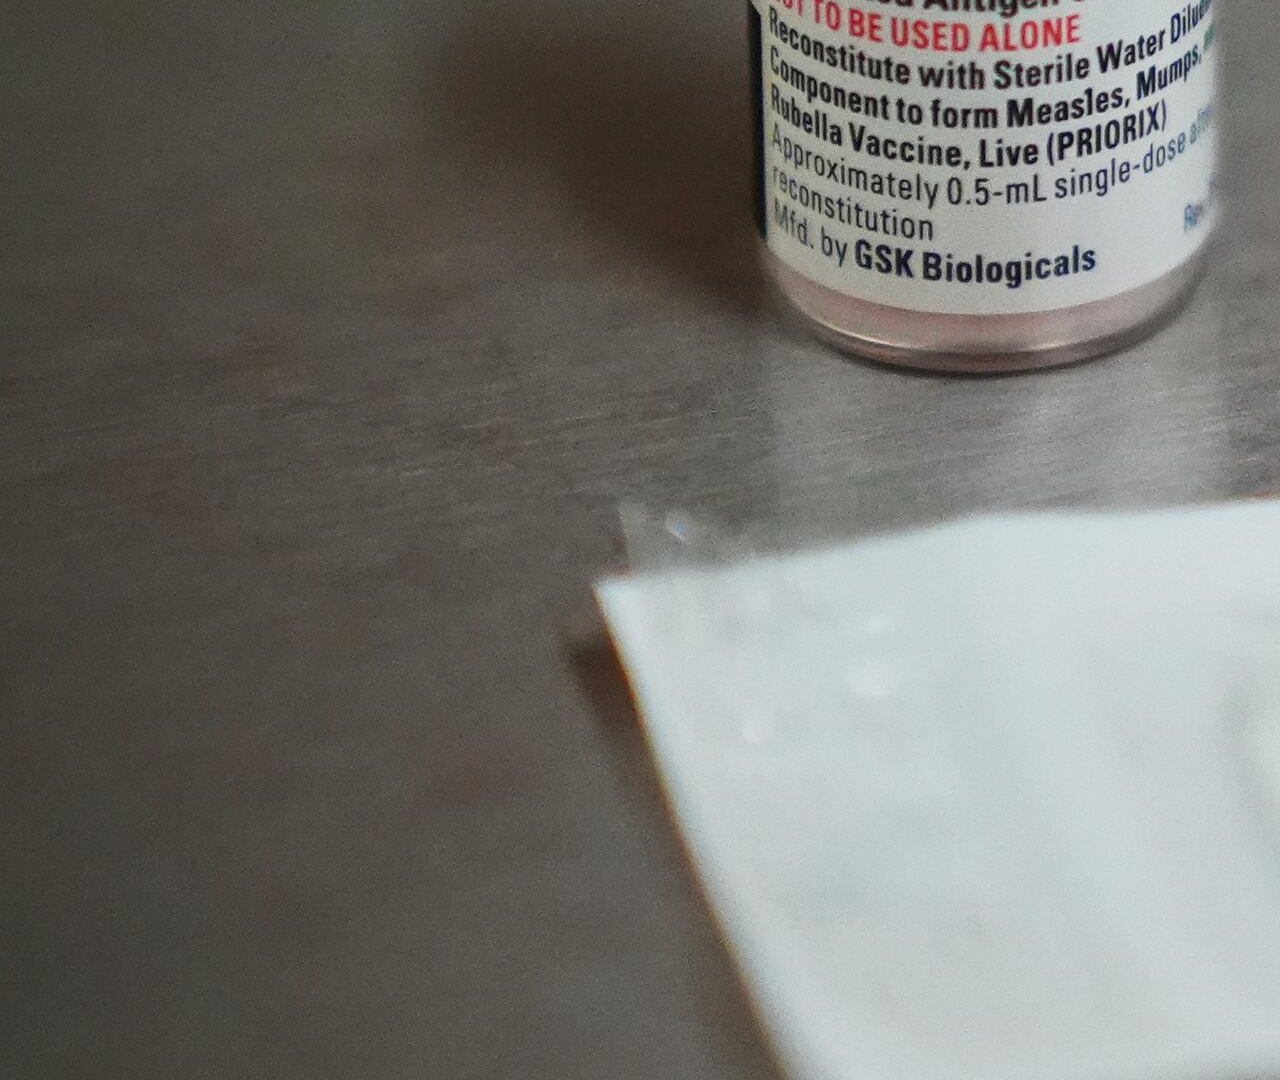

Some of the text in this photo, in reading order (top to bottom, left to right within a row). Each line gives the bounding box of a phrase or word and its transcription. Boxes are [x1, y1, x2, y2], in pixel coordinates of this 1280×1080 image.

[769, 5, 911, 84] Reconstitute
[918, 60, 985, 90] with
[993, 53, 1090, 90] Sterile
[1096, 28, 1166, 74] Water
[849, 8, 882, 42] BE
[891, 16, 970, 52] USED
[979, 14, 1081, 52] ALONE
[770, 45, 891, 121] Component
[896, 98, 923, 126] to
[930, 98, 998, 129] form
[1006, 88, 1130, 128] Measles,
[771, 82, 842, 146] Rubella
[848, 122, 970, 171] Vaccine,
[979, 138, 1039, 168] Live
[1046, 98, 1168, 166] (PRIORIX)
[772, 121, 1186, 210] Approximately 0.5-mL single-dose
[772, 166, 934, 241] reconstitution
[774, 197, 1097, 289] Mfd. by GSK Biologicals
